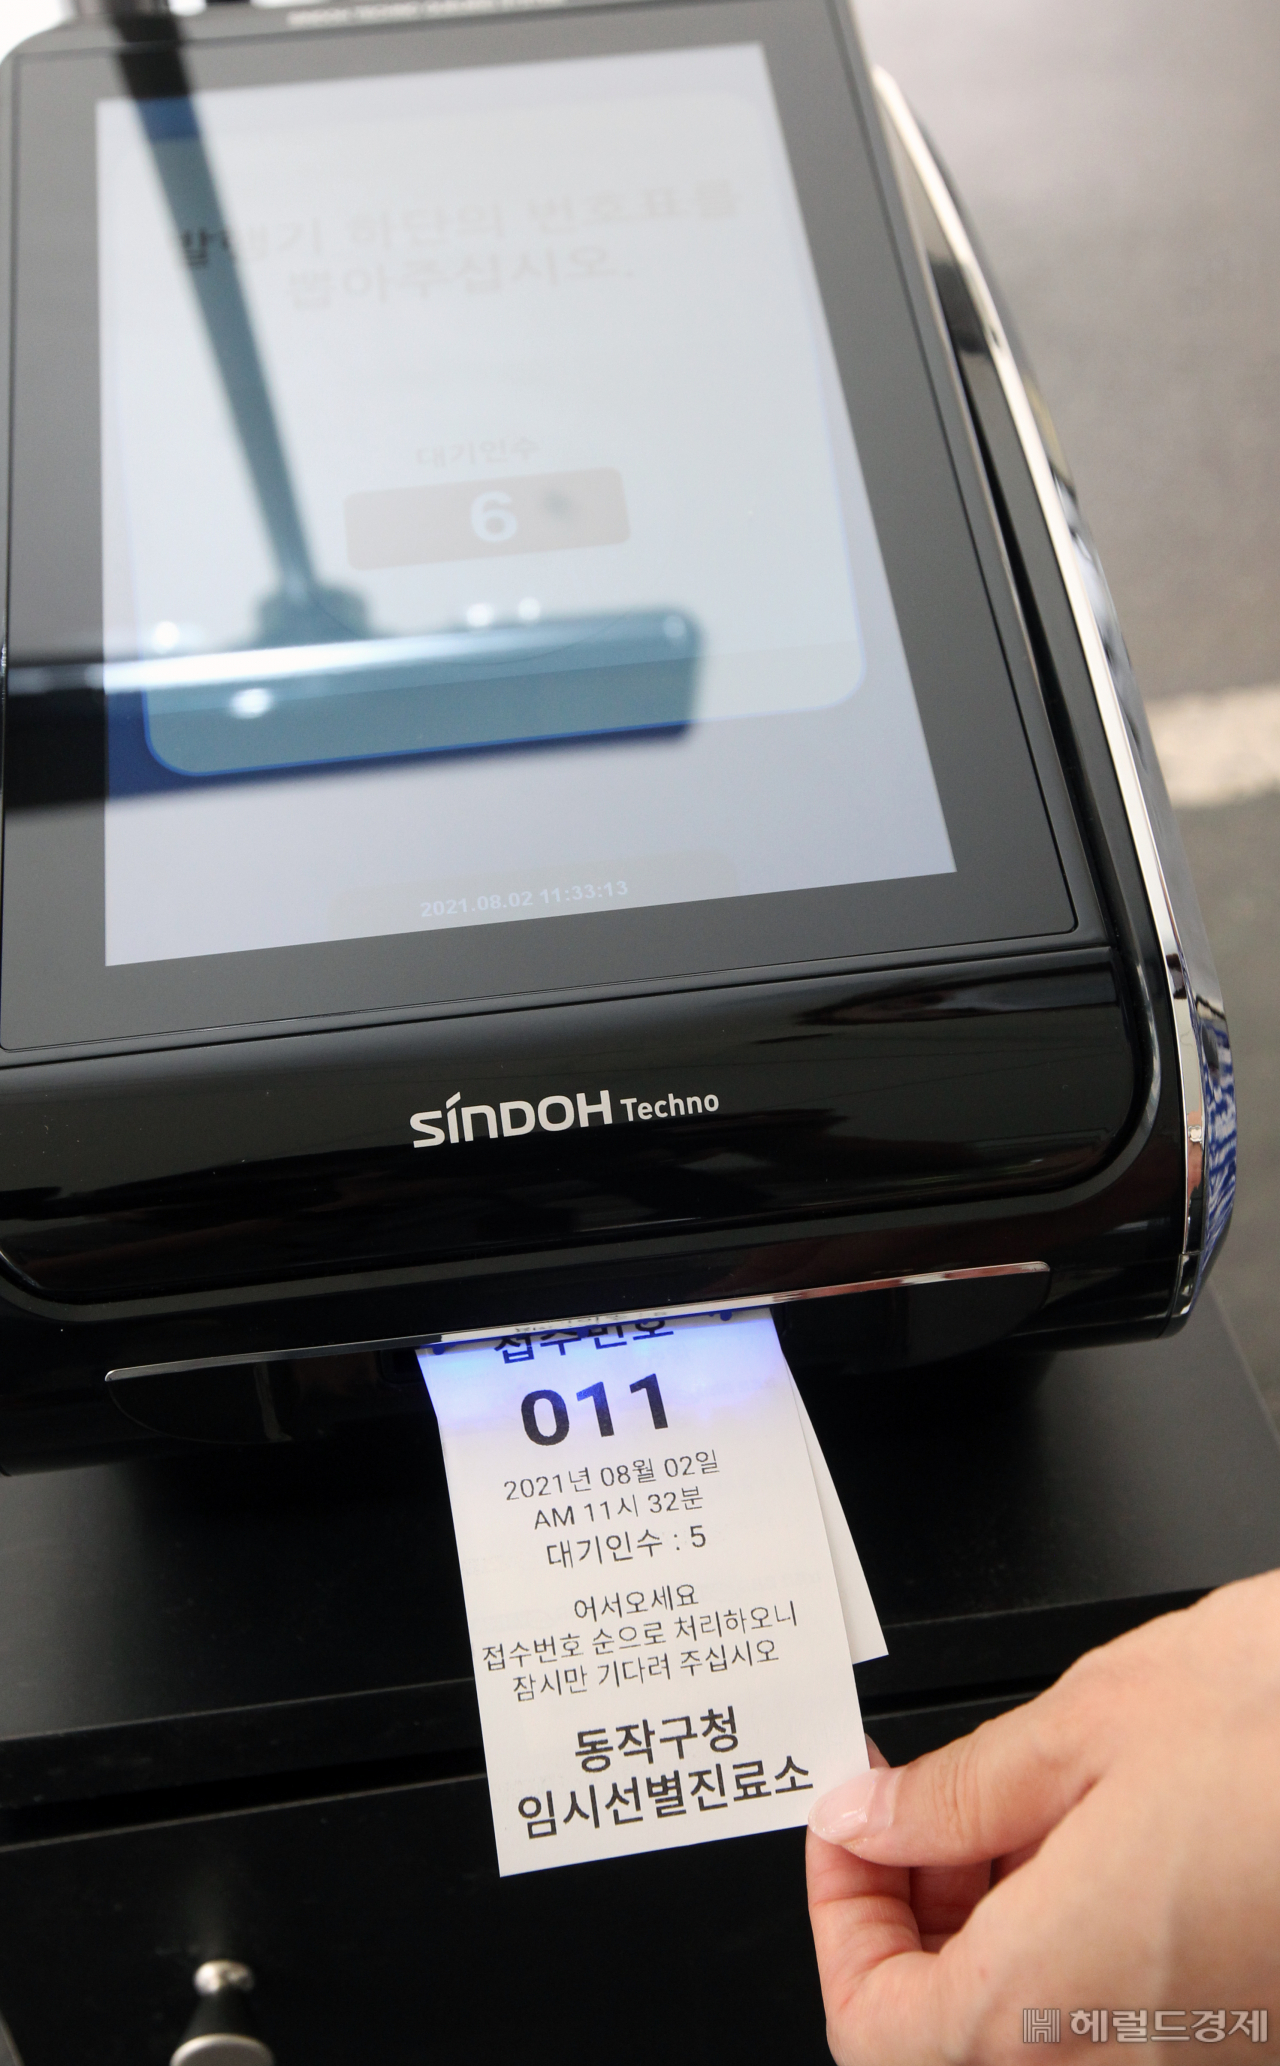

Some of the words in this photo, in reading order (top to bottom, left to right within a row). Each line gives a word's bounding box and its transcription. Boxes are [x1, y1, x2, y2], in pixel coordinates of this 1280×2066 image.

[415, 436, 539, 468] 대기인수
[470, 490, 518, 543] 6
[420, 890, 534, 918] 2021.08.02
[540, 880, 629, 905] 11:33:13
[620, 1093, 720, 1122] Techno
[520, 1373, 669, 1447] 011
[503, 1467, 592, 1501] 2021년
[599, 1458, 657, 1487] 08월
[664, 1449, 721, 1479] 02일
[533, 1505, 576, 1530] AM
[584, 1495, 640, 1521] 11시
[649, 1486, 704, 1514] 32분
[547, 1529, 664, 1569] 대기인수
[691, 1525, 707, 1549] 5
[573, 1583, 700, 1624] 어서오세요
[481, 1633, 585, 1672] 접수번호
[591, 1621, 668, 1655] 순으로
[674, 1600, 799, 1643] 처리하오니
[513, 1665, 588, 1702] 잠시만
[597, 1653, 671, 1689] 기다려
[680, 1638, 780, 1678] 주십시오
[574, 1705, 740, 1773] 동작구청
[517, 1754, 815, 1840] 임시선별진료소
